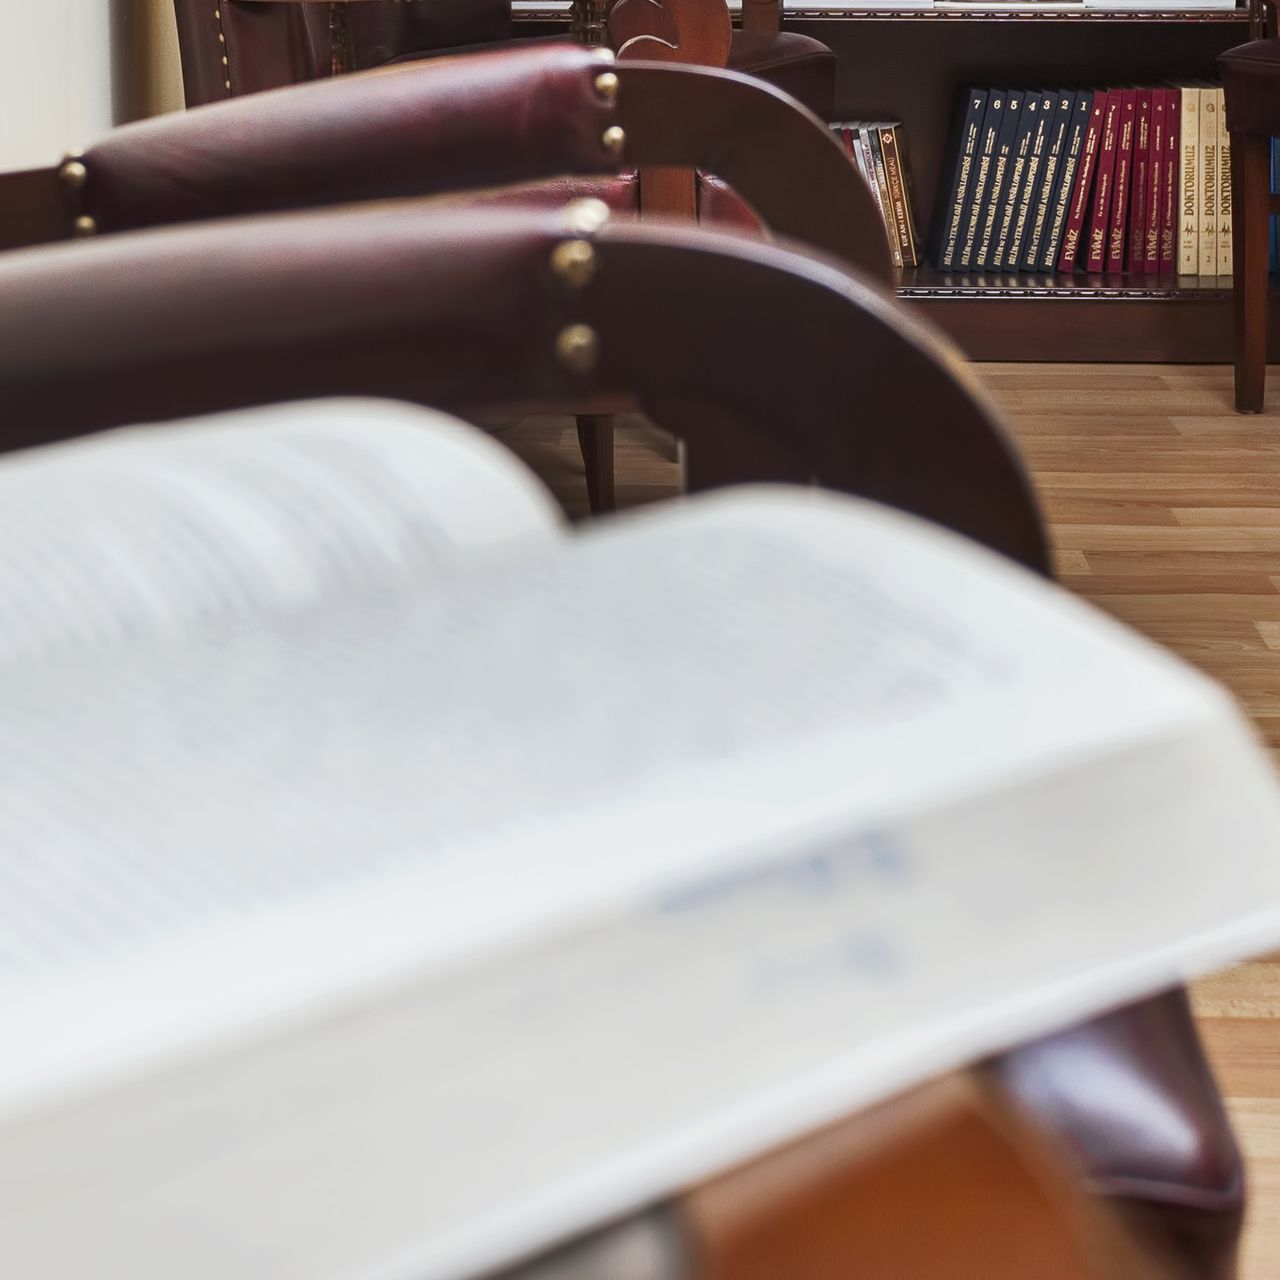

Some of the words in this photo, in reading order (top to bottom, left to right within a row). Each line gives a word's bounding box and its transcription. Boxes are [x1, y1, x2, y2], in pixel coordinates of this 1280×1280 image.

[974, 99, 981, 109] 7
[994, 100, 1001, 109] 6
[1012, 100, 1018, 110] 5
[1029, 101, 1036, 111] 4
[1045, 100, 1051, 110] 3
[1062, 100, 1069, 110] 2
[1082, 101, 1086, 111] 1
[892, 176, 902, 199] TÜRKÇE
[1184, 145, 1196, 216] DOKTORUMUZ
[1204, 145, 1215, 216] DOKTORUMUZ
[1221, 146, 1231, 216] DOKTORUMUZ
[1064, 228, 1079, 261] EVİMİZ
[1092, 228, 1104, 261] EVİMİZ
[1112, 228, 1122, 261] EVİMİZ
[1148, 228, 1158, 261] EVİMİZ
[944, 246, 954, 266] BİLİM
[962, 246, 972, 266] BİLİM
[977, 246, 987, 266] BİLİM
[993, 246, 1003, 266] BİLİM
[1008, 246, 1019, 266] BİLİM
[1027, 246, 1037, 266] BİLİM
[1045, 246, 1055, 266] BİLİM
